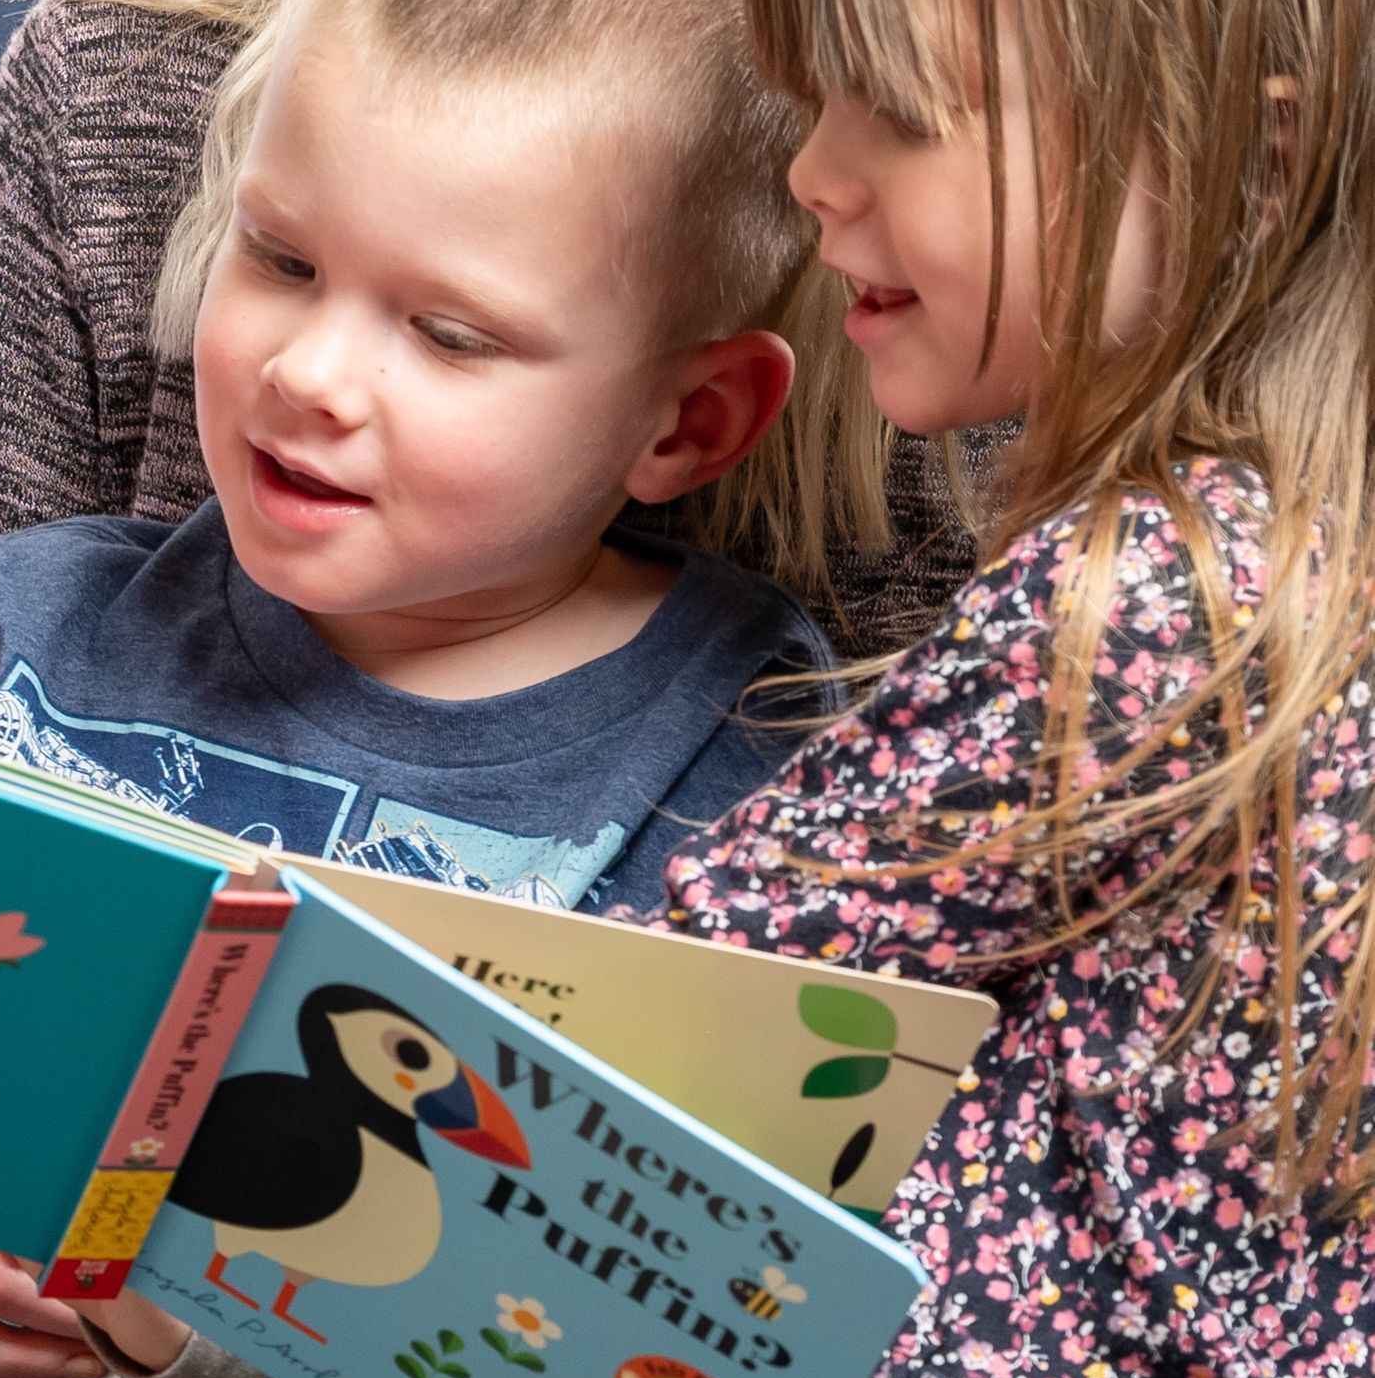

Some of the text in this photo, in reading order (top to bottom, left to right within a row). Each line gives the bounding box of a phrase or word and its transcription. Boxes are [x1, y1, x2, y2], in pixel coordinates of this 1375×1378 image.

[145, 943, 250, 1132] Where's the Puffin?
[490, 1033, 803, 1264] Where's
[580, 1178, 690, 1263] the
[474, 1167, 793, 1372] Puffin?
